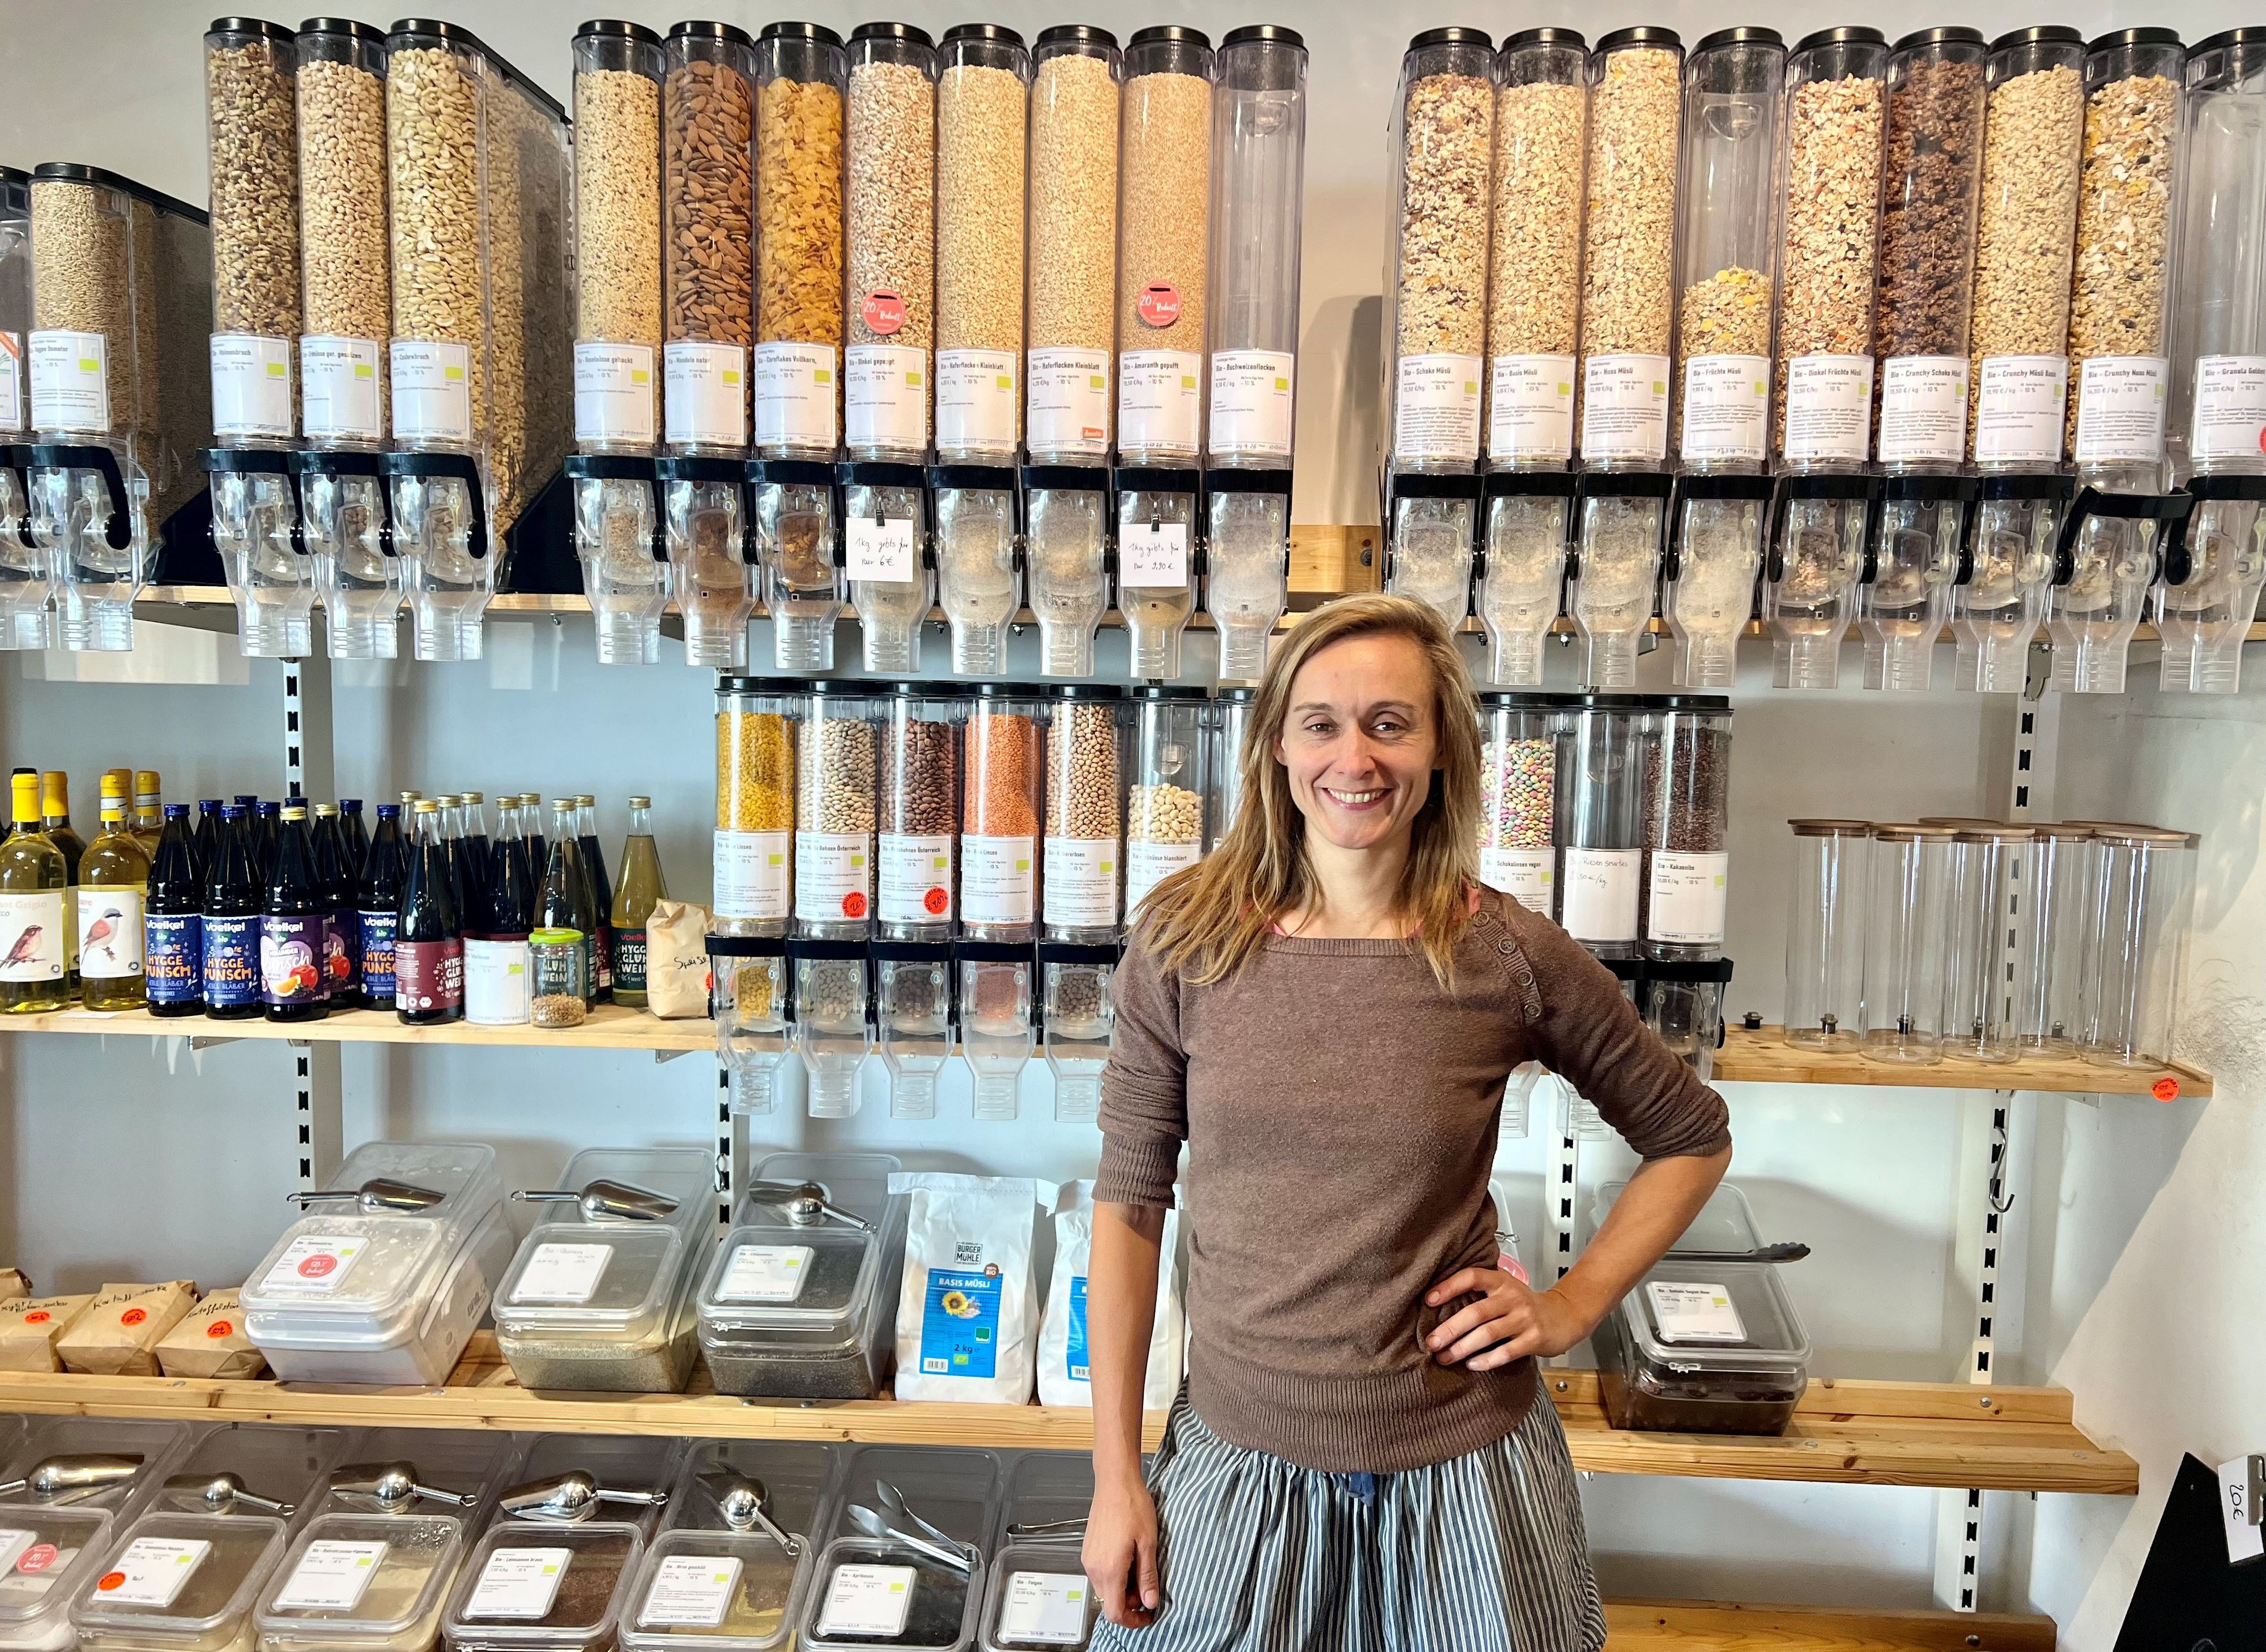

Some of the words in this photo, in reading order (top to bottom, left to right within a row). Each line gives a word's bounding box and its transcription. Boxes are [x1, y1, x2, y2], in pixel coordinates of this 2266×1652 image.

[1140, 294, 1151, 306] 20
[863, 301, 876, 313] 20
[1226, 362, 1275, 371] Buchweizenflocken
[1906, 370, 1930, 379] Crunchy
[925, 887, 945, 911] REDUZIERT
[146, 920, 184, 930] Voelkel
[206, 922, 245, 933] Voelkel
[263, 921, 303, 933] Voelkel
[148, 955, 183, 966] HYGGE
[207, 958, 244, 968] HYGGE
[146, 965, 191, 977] PUNSCH
[204, 967, 252, 981] PUNSCH
[957, 1245, 981, 1253] BURGER
[956, 1253, 979, 1262] MÜHLE
[939, 1278, 962, 1286] BASIS
[965, 1279, 990, 1287] MÜSLI
[962, 1344, 973, 1354] kg
[2229, 1484, 2245, 1521] 20€
